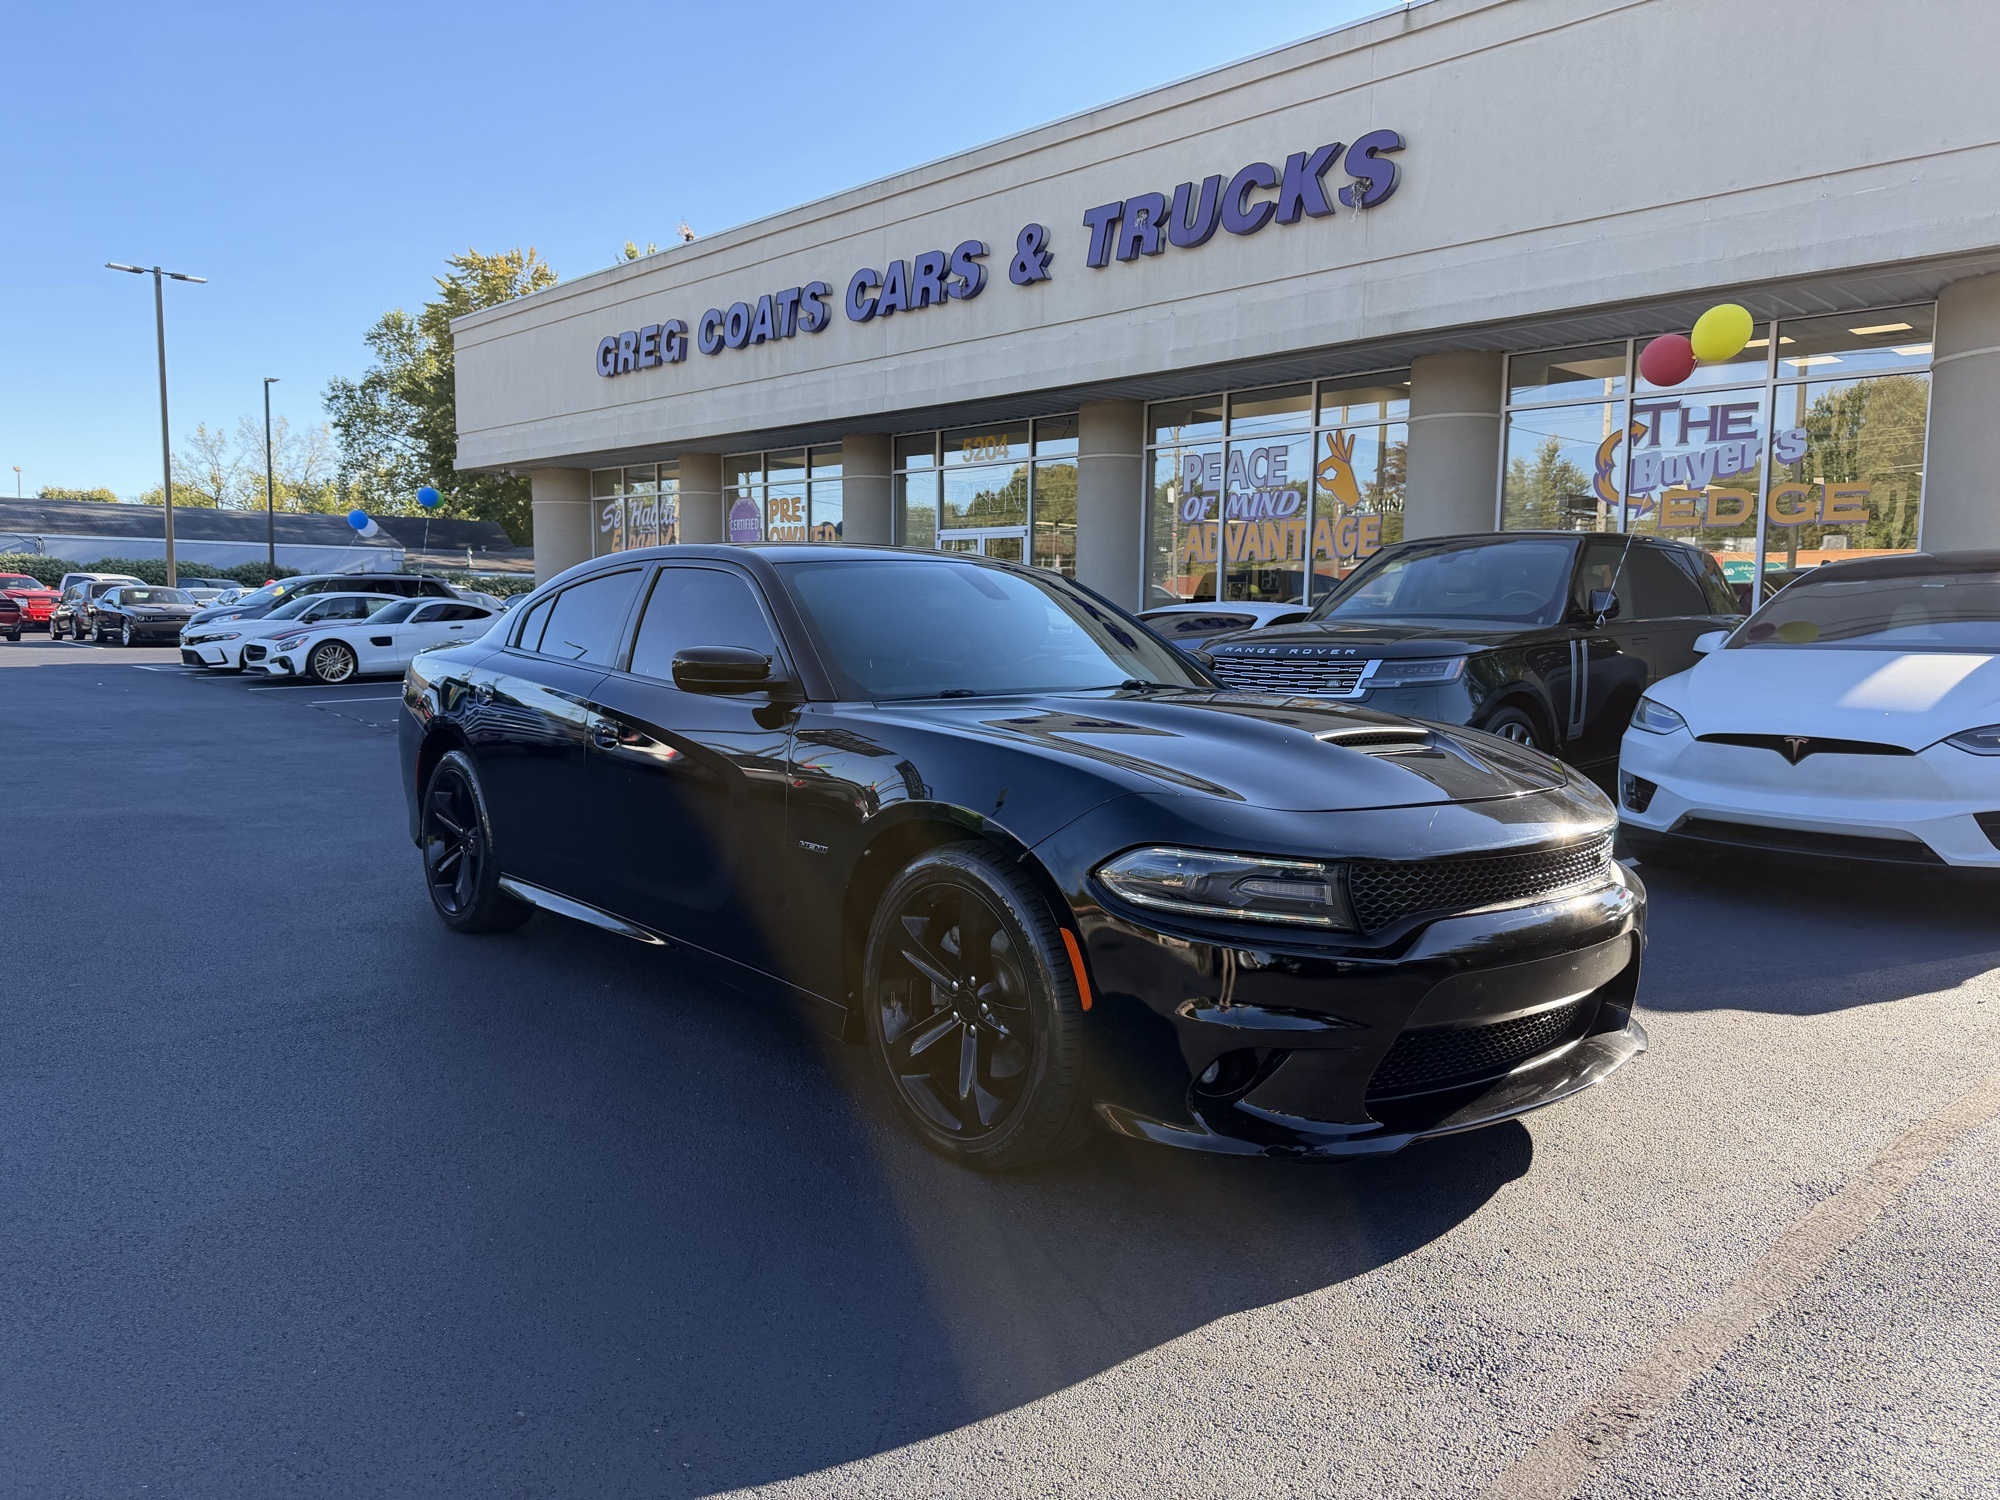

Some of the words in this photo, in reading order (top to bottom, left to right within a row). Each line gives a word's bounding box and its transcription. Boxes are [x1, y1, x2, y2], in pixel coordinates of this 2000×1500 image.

[597, 318, 688, 378] GREG
[697, 281, 833, 355] COATS
[845, 239, 988, 324] CARS
[1008, 223, 1052, 286] &
[1082, 128, 1406, 270] TRUCKS
[1632, 400, 1760, 449] THE
[961, 433, 1009, 463] 5204
[1182, 444, 1290, 494] PEACE
[601, 503, 622, 533] Se
[769, 496, 806, 524] PRE-
[1181, 495, 1217, 523] OF
[1225, 490, 1301, 522] MIND
[1657, 481, 1871, 529] EDGE
[730, 518, 759, 531] CERTIFIED
[1180, 514, 1384, 564] ADVANTAGE
[1225, 646, 1278, 654] RANGE
[1288, 648, 1356, 656] ROVER
[799, 840, 828, 854] HEMI
